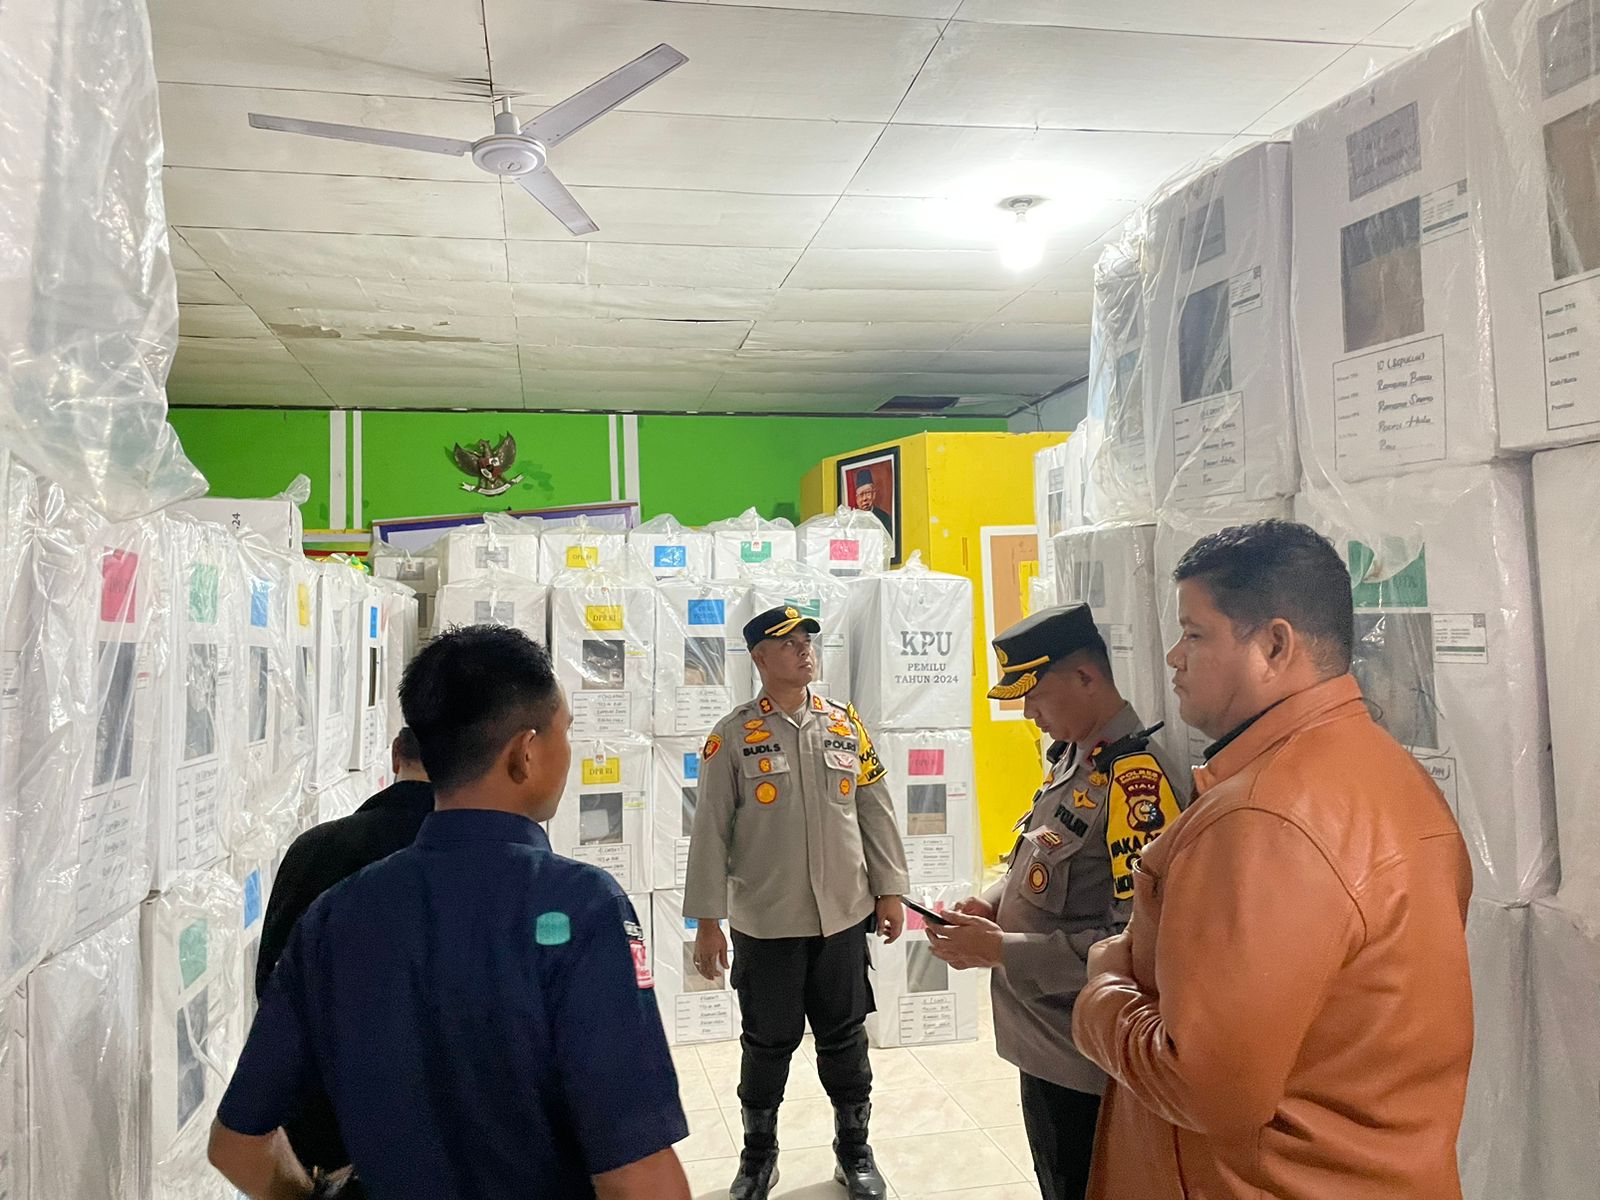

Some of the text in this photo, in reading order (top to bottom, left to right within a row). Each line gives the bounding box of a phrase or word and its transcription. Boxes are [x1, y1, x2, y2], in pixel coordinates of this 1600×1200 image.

[900, 630, 953, 657] KPU
[907, 663, 947, 672] PEMILU
[895, 675, 959, 684] TAHUN 2024
[824, 739, 857, 752] POLRI
[1127, 783, 1156, 792] RIAU
